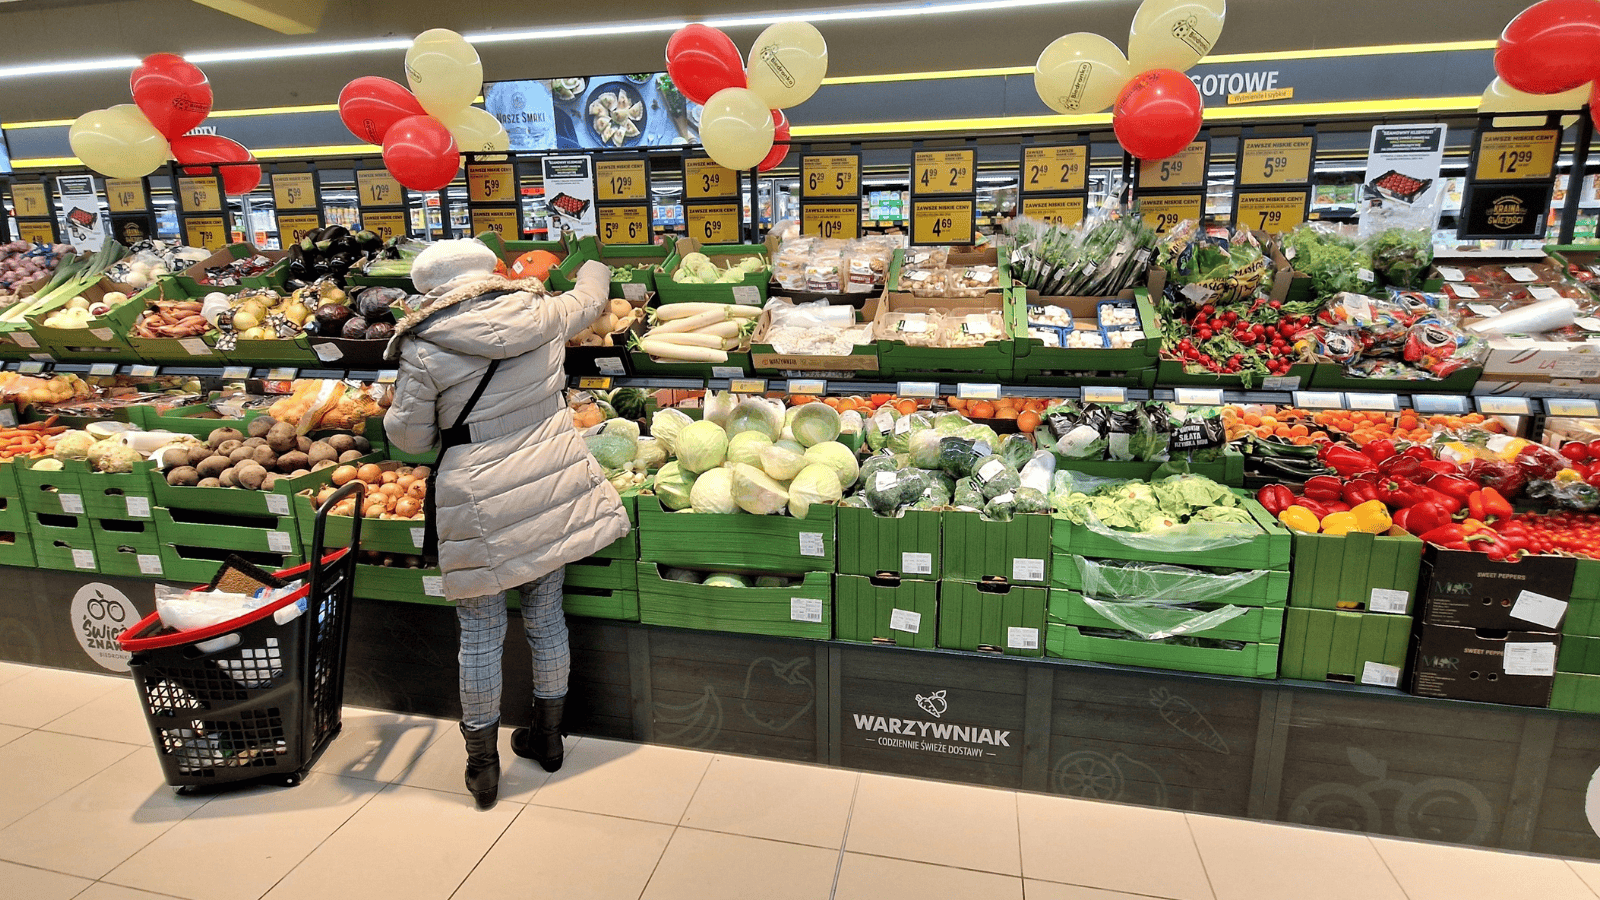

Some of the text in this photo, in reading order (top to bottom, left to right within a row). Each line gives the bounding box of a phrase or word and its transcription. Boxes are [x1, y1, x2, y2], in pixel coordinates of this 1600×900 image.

[1190, 71, 1279, 97] GOTOWE
[1498, 573, 1526, 581] PEPPERS
[1464, 647, 1504, 657] SWEET PEPPE
[853, 713, 1011, 748] WARZYWNIAK
[878, 736, 984, 758] CODZIENNIE ŚWIEŻE DOSTAWY
